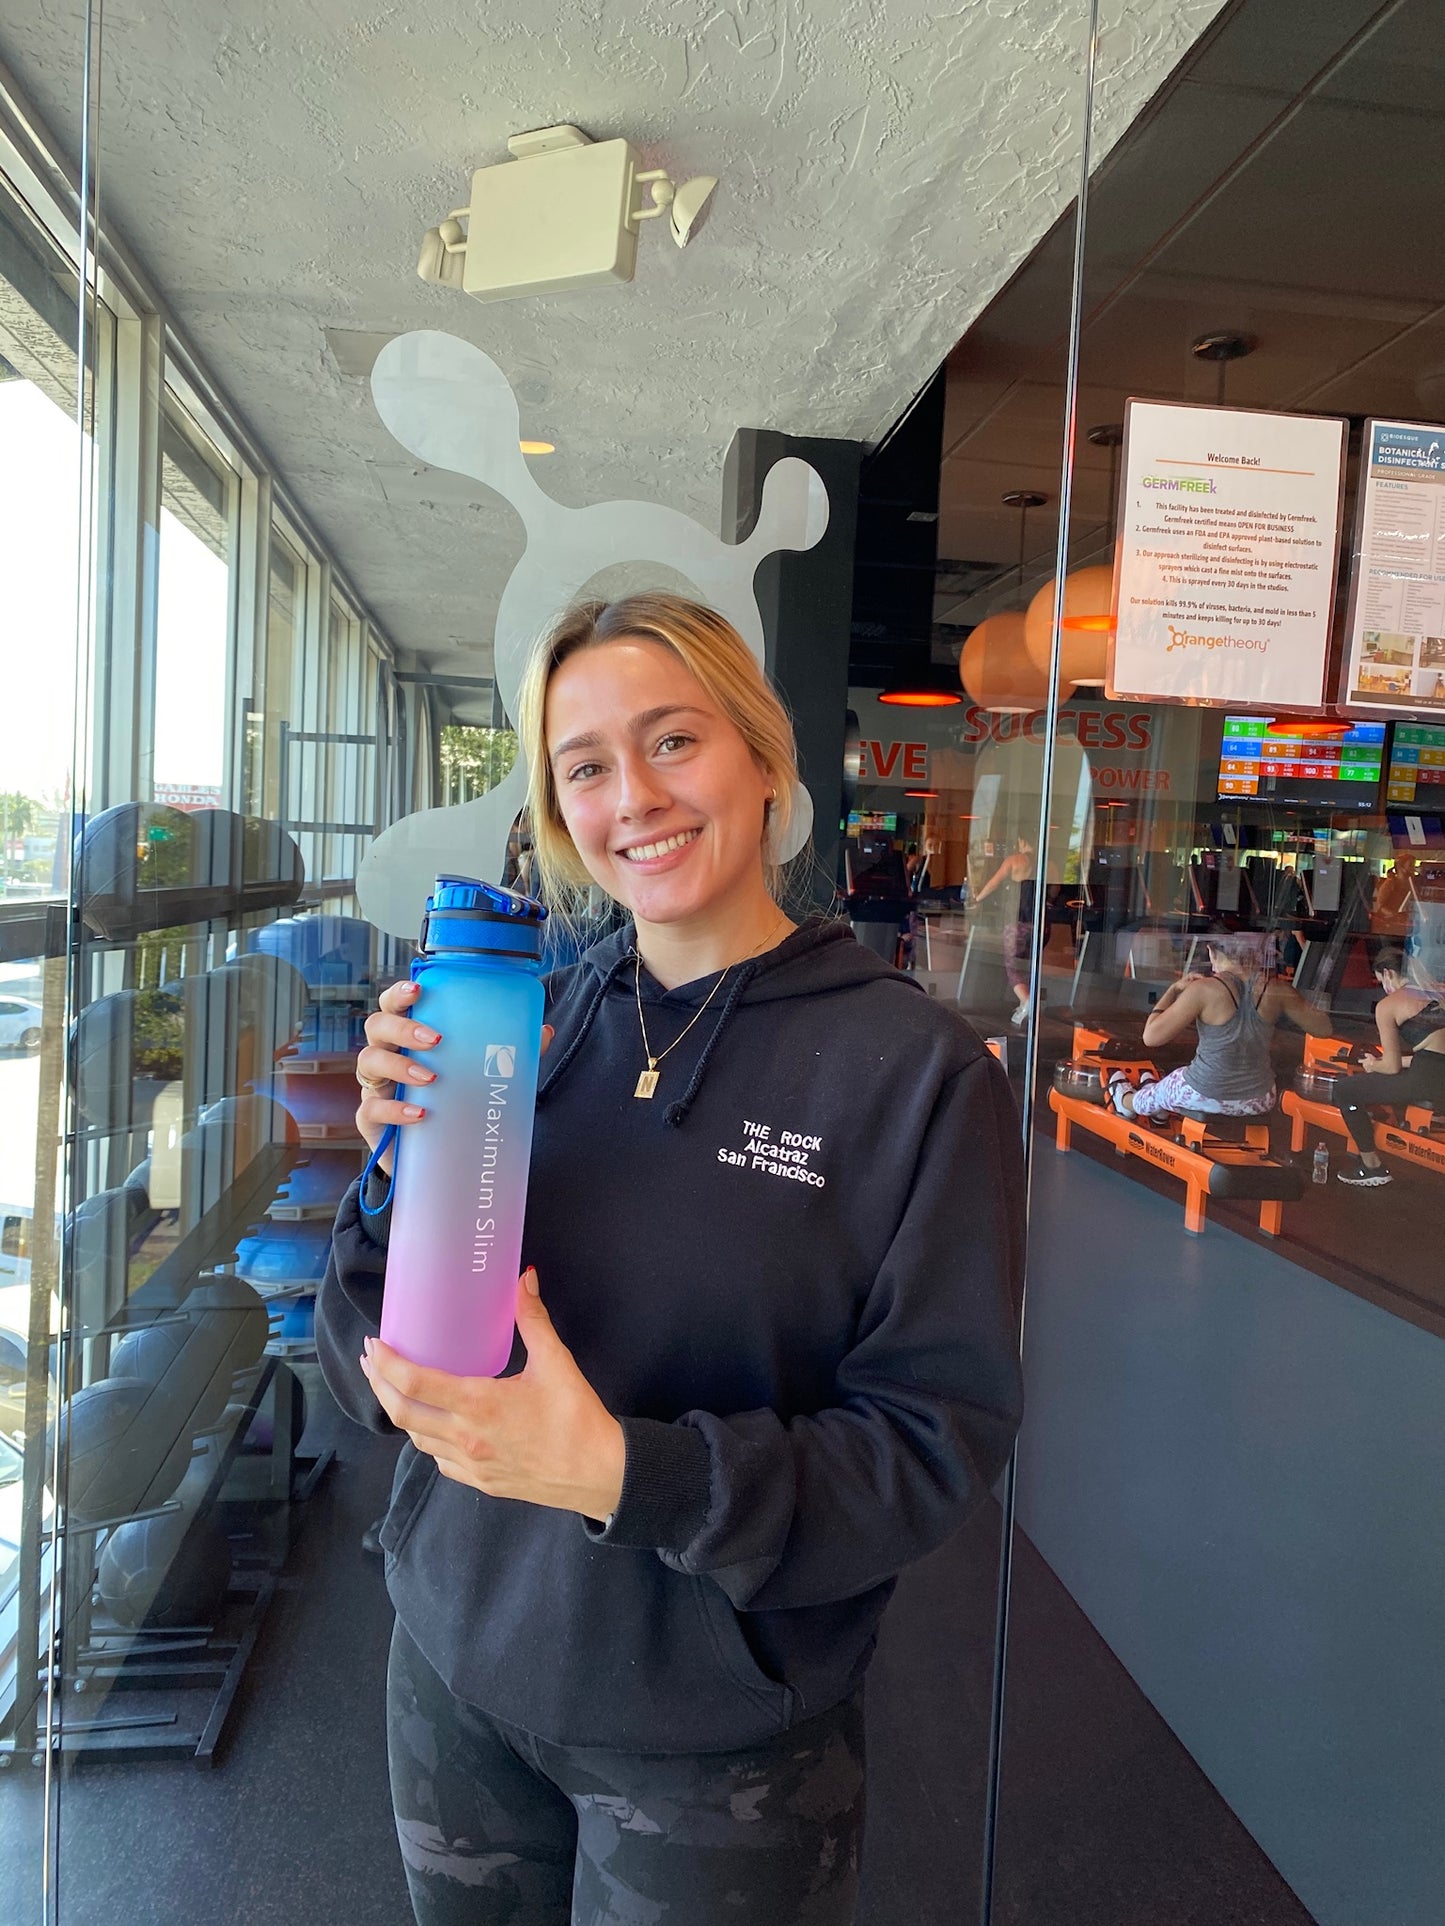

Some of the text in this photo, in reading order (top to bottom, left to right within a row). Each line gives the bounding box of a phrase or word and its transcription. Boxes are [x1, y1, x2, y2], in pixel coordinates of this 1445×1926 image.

[1389, 433, 1419, 441] BIOESQUE
[1207, 453, 1261, 466] Welcome Back!
[1379, 447, 1427, 459] BOTANICAL
[1378, 456, 1439, 468] DISINFECTANT
[1376, 481, 1408, 490] FEATURES
[1156, 502, 1167, 510] This
[1168, 504, 1188, 513] facility
[1189, 505, 1199, 513] has
[1200, 506, 1214, 514] been
[1215, 508, 1236, 516] treated
[1248, 510, 1278, 520] disinfected
[1280, 513, 1287, 522] by
[1288, 513, 1317, 523] Germfreek.
[1164, 515, 1193, 524] Germfreek
[1194, 518, 1217, 527] certified
[1238, 522, 1253, 530] OPEN
[1254, 523, 1266, 531] FOR
[1267, 524, 1294, 533] BUSINESS
[1142, 525, 1171, 534] Germfreek
[1195, 529, 1206, 537] FDA
[1219, 531, 1230, 539] EPA
[1231, 534, 1257, 542] approved
[1258, 535, 1291, 544] plant-based
[1292, 538, 1315, 546] solution
[1203, 542, 1253, 553] disinfect surfaces.
[1154, 552, 1180, 560] approach
[1181, 553, 1209, 563] sterilizing
[1222, 556, 1253, 566] disinfecting
[1260, 559, 1268, 567] by
[1268, 560, 1284, 569] using
[1284, 561, 1318, 570] electrostatic
[1159, 564, 1183, 572] sprayers
[1218, 567, 1229, 575] fine
[1231, 568, 1243, 576] mist
[1258, 570, 1267, 578] the
[1268, 571, 1293, 580] surfaces.
[1169, 575, 1181, 584] This
[1182, 576, 1187, 584] is
[1188, 578, 1210, 587] sprayed
[1211, 580, 1226, 588] every
[1228, 580, 1235, 588] 30
[1236, 581, 1249, 590] days
[1250, 582, 1256, 590] in
[1267, 584, 1289, 592] studios.
[1142, 598, 1164, 606] solution
[1165, 599, 1178, 607] kills
[1178, 600, 1197, 609] 99.9%
[1206, 603, 1227, 612] viruses,
[1228, 604, 1252, 613] bacteria,
[1162, 612, 1185, 620] minutes
[1197, 615, 1214, 623] keeps
[1215, 615, 1232, 625] killing
[1243, 618, 1250, 626] up
[1258, 618, 1265, 626] 30
[1267, 619, 1282, 628] days!
[1166, 625, 1268, 653] Orangetheory
[964, 705, 1151, 750] SUCCESS
[1088, 767, 1171, 790] POWER
[154, 794, 218, 805] HONDA
[641, 1076, 654, 1092] N
[743, 1120, 822, 1151] THE ROCK
[744, 1139, 809, 1165] Alcatraz
[1145, 1140, 1175, 1168] WaterRower
[717, 1148, 825, 1187] San Francisco
[472, 1083, 508, 1272] Maximum Slim
